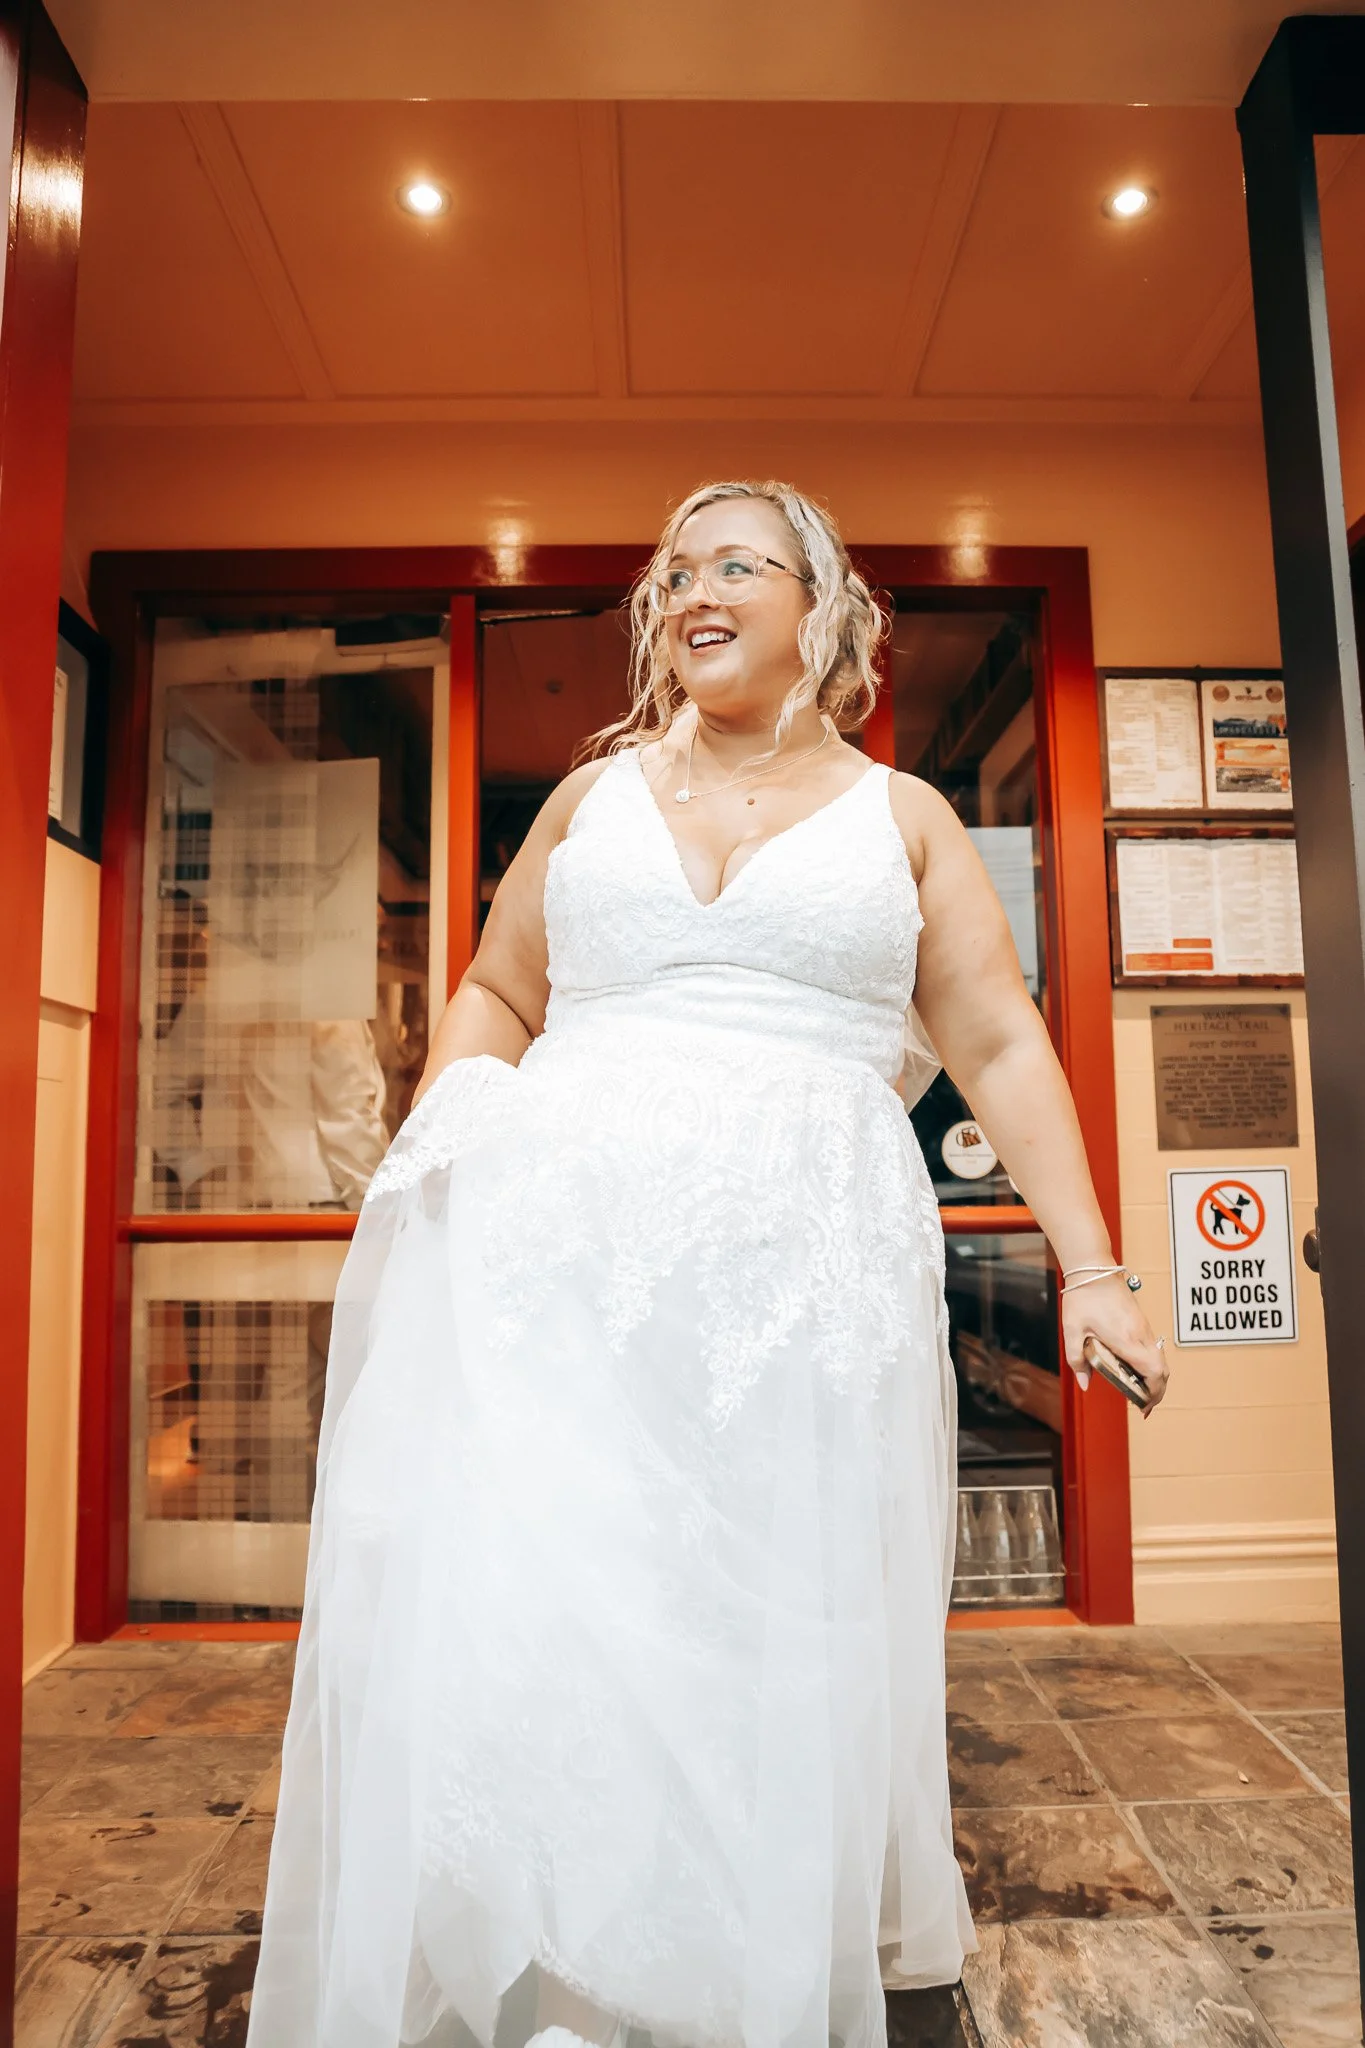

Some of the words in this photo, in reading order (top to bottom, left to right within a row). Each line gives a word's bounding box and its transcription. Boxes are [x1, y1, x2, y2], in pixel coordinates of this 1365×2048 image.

[1174, 1022, 1231, 1032] HERITAGE
[1239, 1021, 1269, 1031] TRAIL
[1201, 1259, 1265, 1280] SORRY
[1191, 1286, 1217, 1305] NO
[1226, 1284, 1278, 1304] DOGS
[1190, 1310, 1283, 1331] ALLOWED
